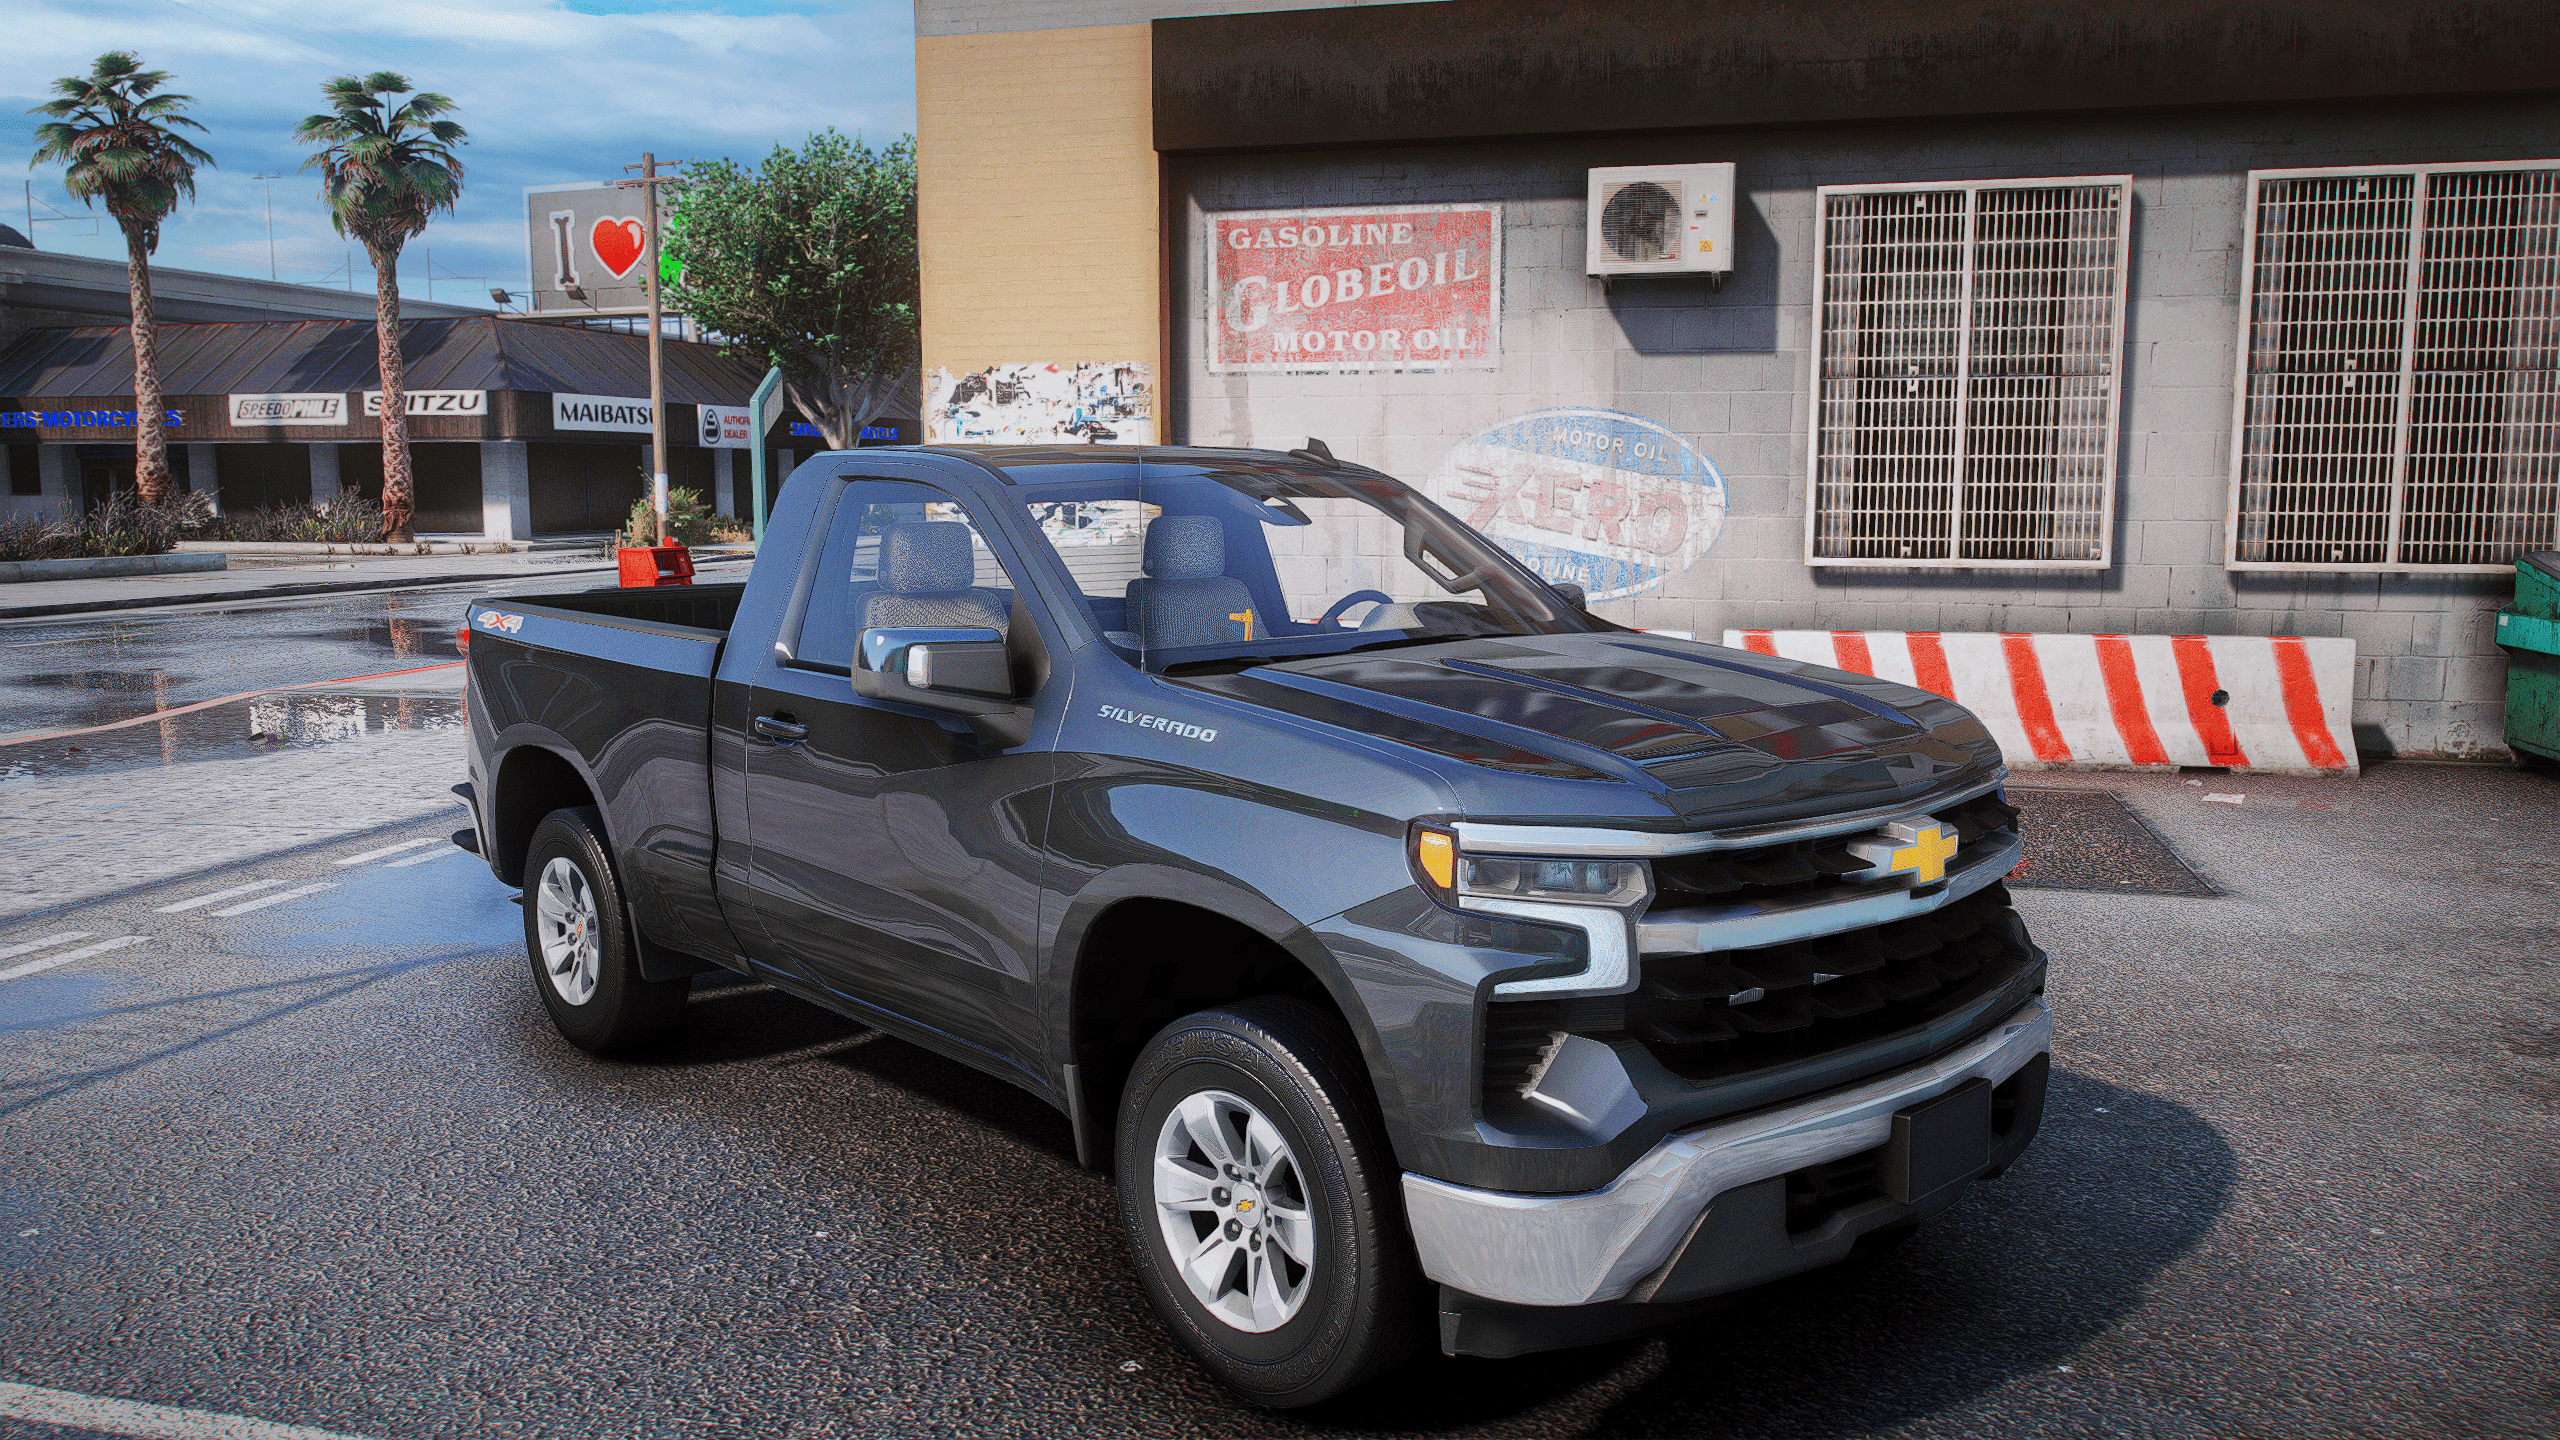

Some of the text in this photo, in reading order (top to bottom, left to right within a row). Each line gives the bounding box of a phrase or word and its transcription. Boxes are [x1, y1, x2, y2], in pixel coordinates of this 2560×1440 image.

[1228, 222, 1413, 250] GASOLINE
[1224, 250, 1479, 332] GLOBEOIL
[1272, 327, 1479, 352] MOTOR OIL
[368, 394, 480, 413] SITZU
[0, 410, 180, 428] ERS MOTORCYS
[792, 422, 823, 437] SAND
[724, 429, 748, 439] DEALER
[1552, 426, 1669, 464] MOTOR OIL
[1447, 462, 1689, 556] XERO
[1097, 704, 1219, 743] SILVERADO
